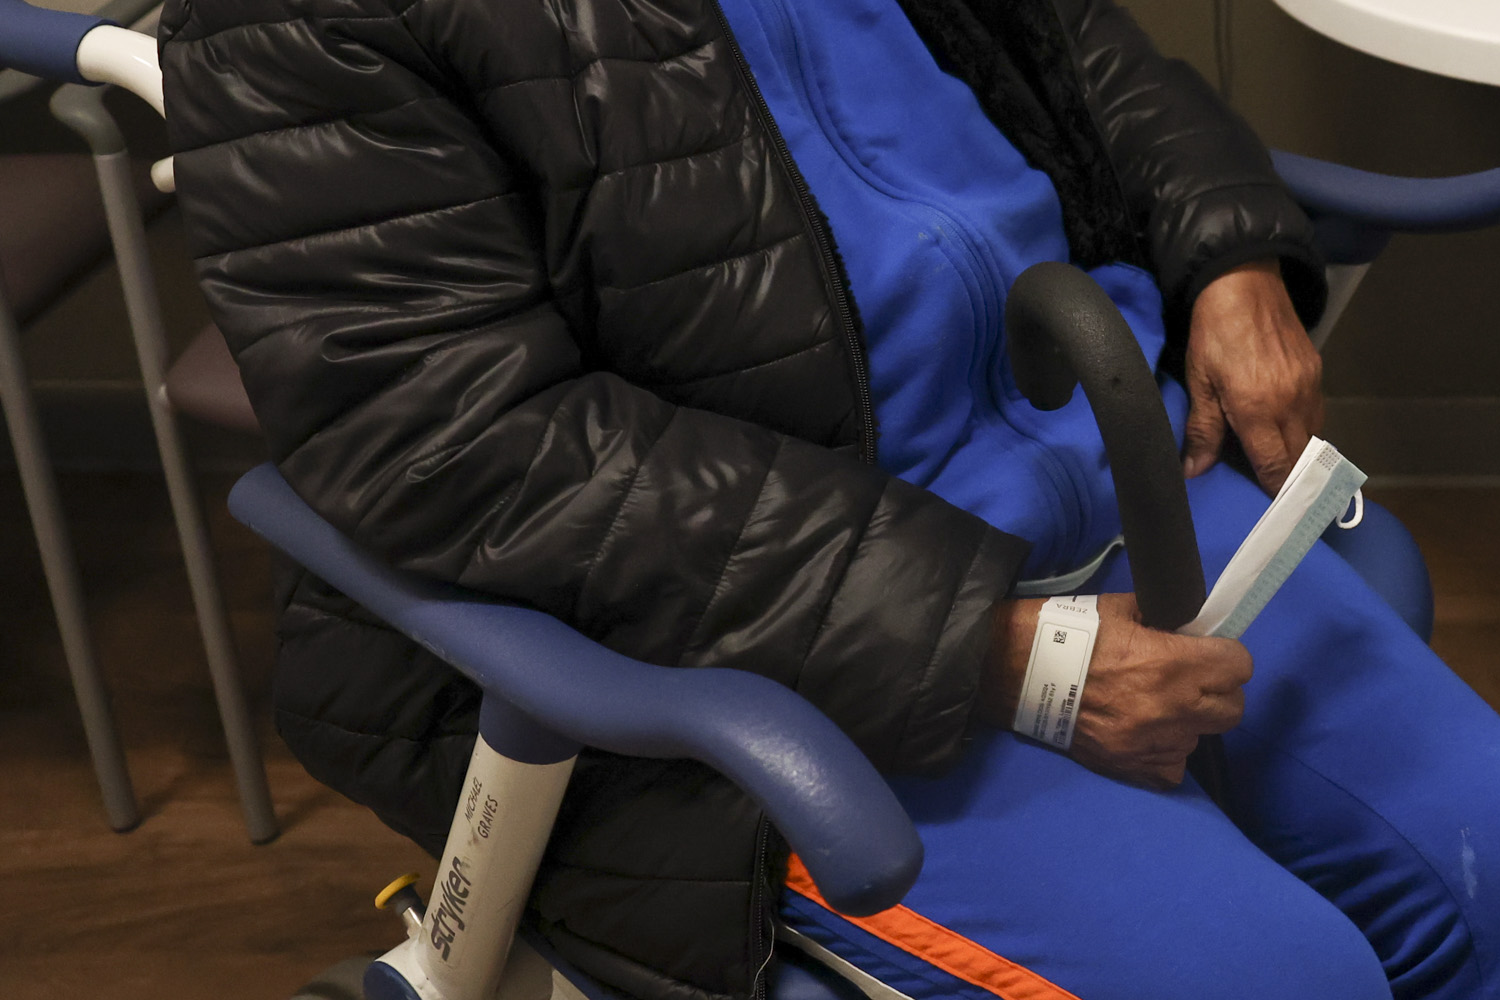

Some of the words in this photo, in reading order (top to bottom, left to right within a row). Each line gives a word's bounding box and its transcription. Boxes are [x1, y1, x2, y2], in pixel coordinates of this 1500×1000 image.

[1056, 603, 1088, 615] ZEBRA
[464, 776, 483, 824] MICHAEL
[477, 794, 498, 839] GRAVES
[430, 856, 472, 962] stryker
